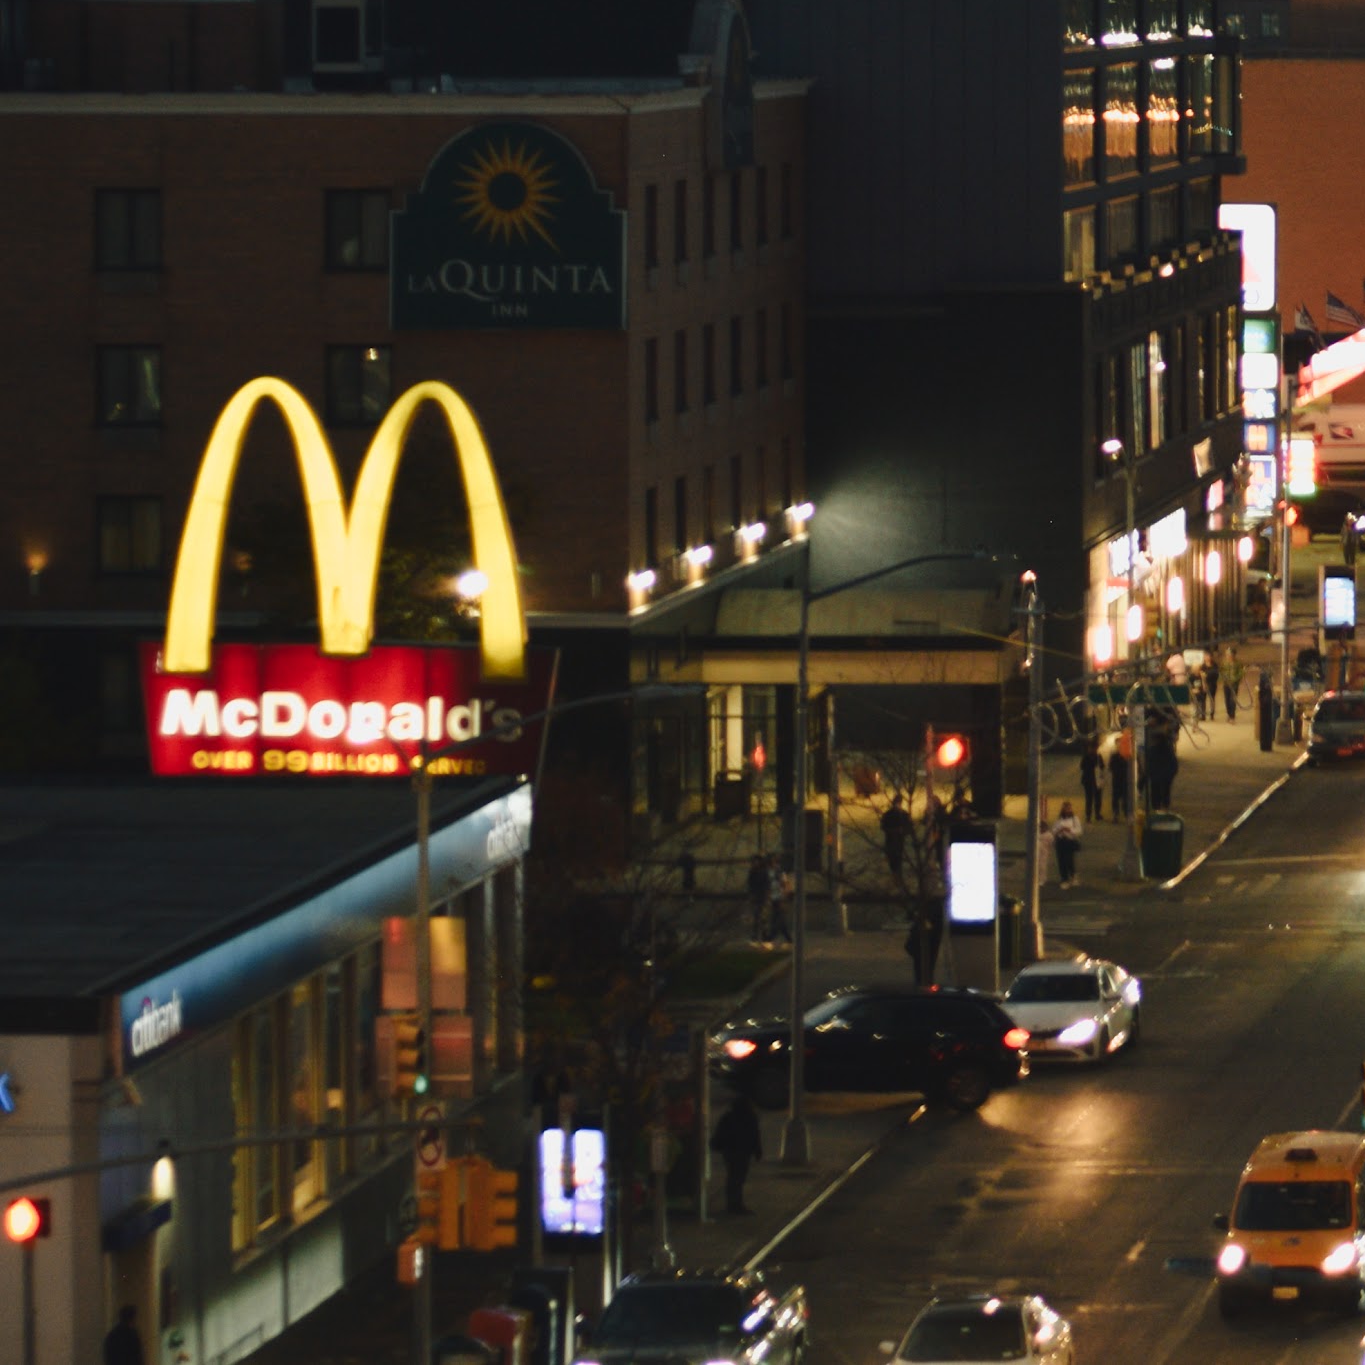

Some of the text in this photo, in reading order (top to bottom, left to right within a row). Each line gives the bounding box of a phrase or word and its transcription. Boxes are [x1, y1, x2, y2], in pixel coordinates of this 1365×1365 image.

[438, 258, 612, 302] QUINTA
[491, 303, 529, 318] INN
[160, 687, 524, 743] McDonald's
[191, 750, 253, 769] OVER
[262, 749, 308, 772] 99
[312, 751, 399, 772] BILLION
[131, 988, 183, 1057] citibank
